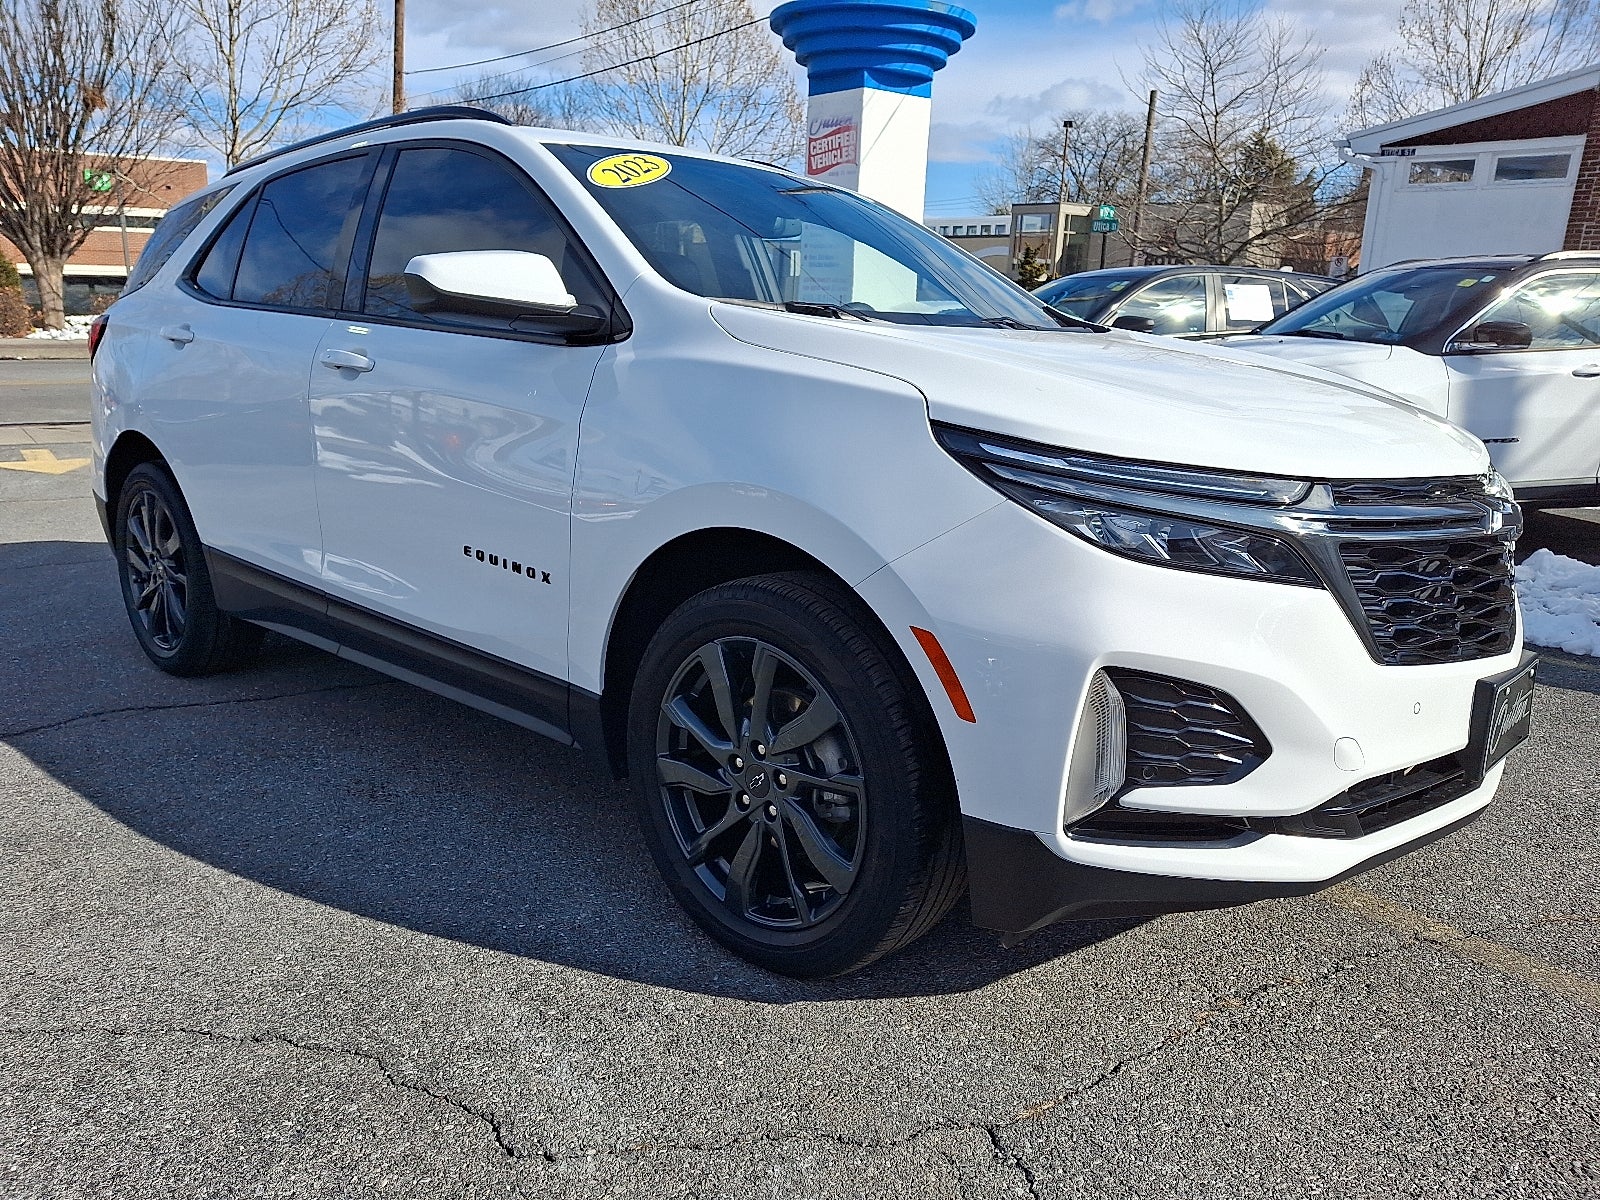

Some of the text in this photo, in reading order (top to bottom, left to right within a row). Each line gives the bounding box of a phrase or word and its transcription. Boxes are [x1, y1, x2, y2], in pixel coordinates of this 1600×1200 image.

[809, 130, 857, 156] CERTIFIED
[601, 156, 660, 184] 2023
[810, 145, 856, 170] VEHICLES
[1093, 220, 1110, 232] Utica
[463, 545, 552, 585] EQUINOX
